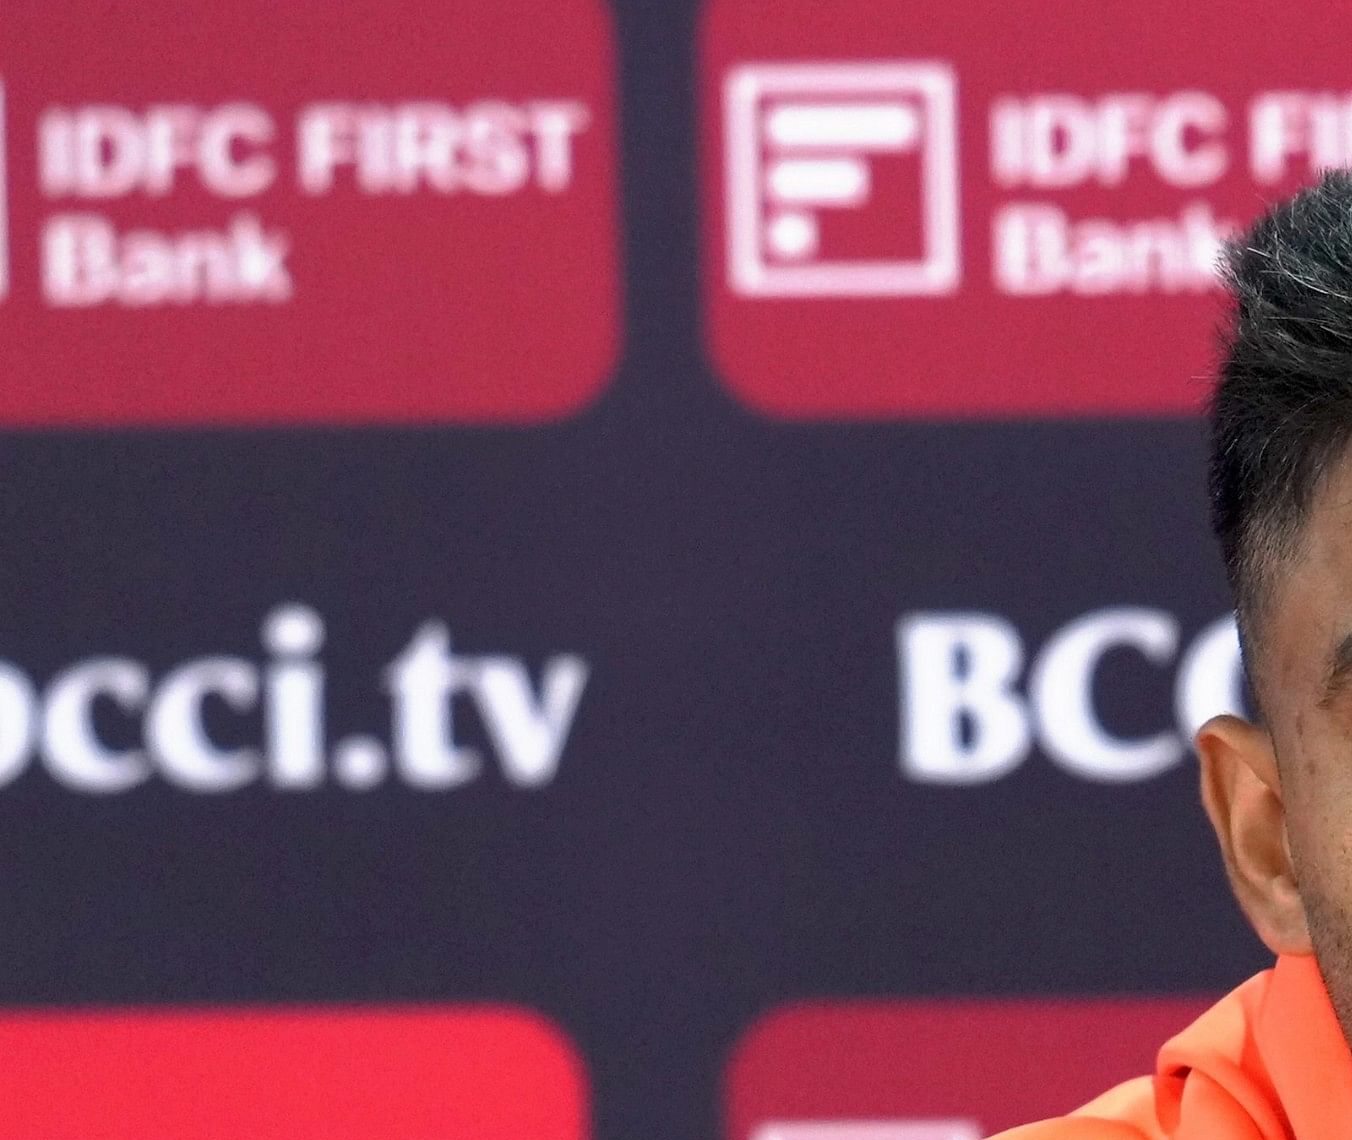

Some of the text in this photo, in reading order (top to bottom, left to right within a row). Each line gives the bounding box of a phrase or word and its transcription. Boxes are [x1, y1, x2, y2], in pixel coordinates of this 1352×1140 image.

[38, 100, 588, 196] IDFC FIRST
[989, 93, 1228, 188] IDFC
[39, 212, 293, 305] Bank
[0, 603, 587, 792] cci.tv
